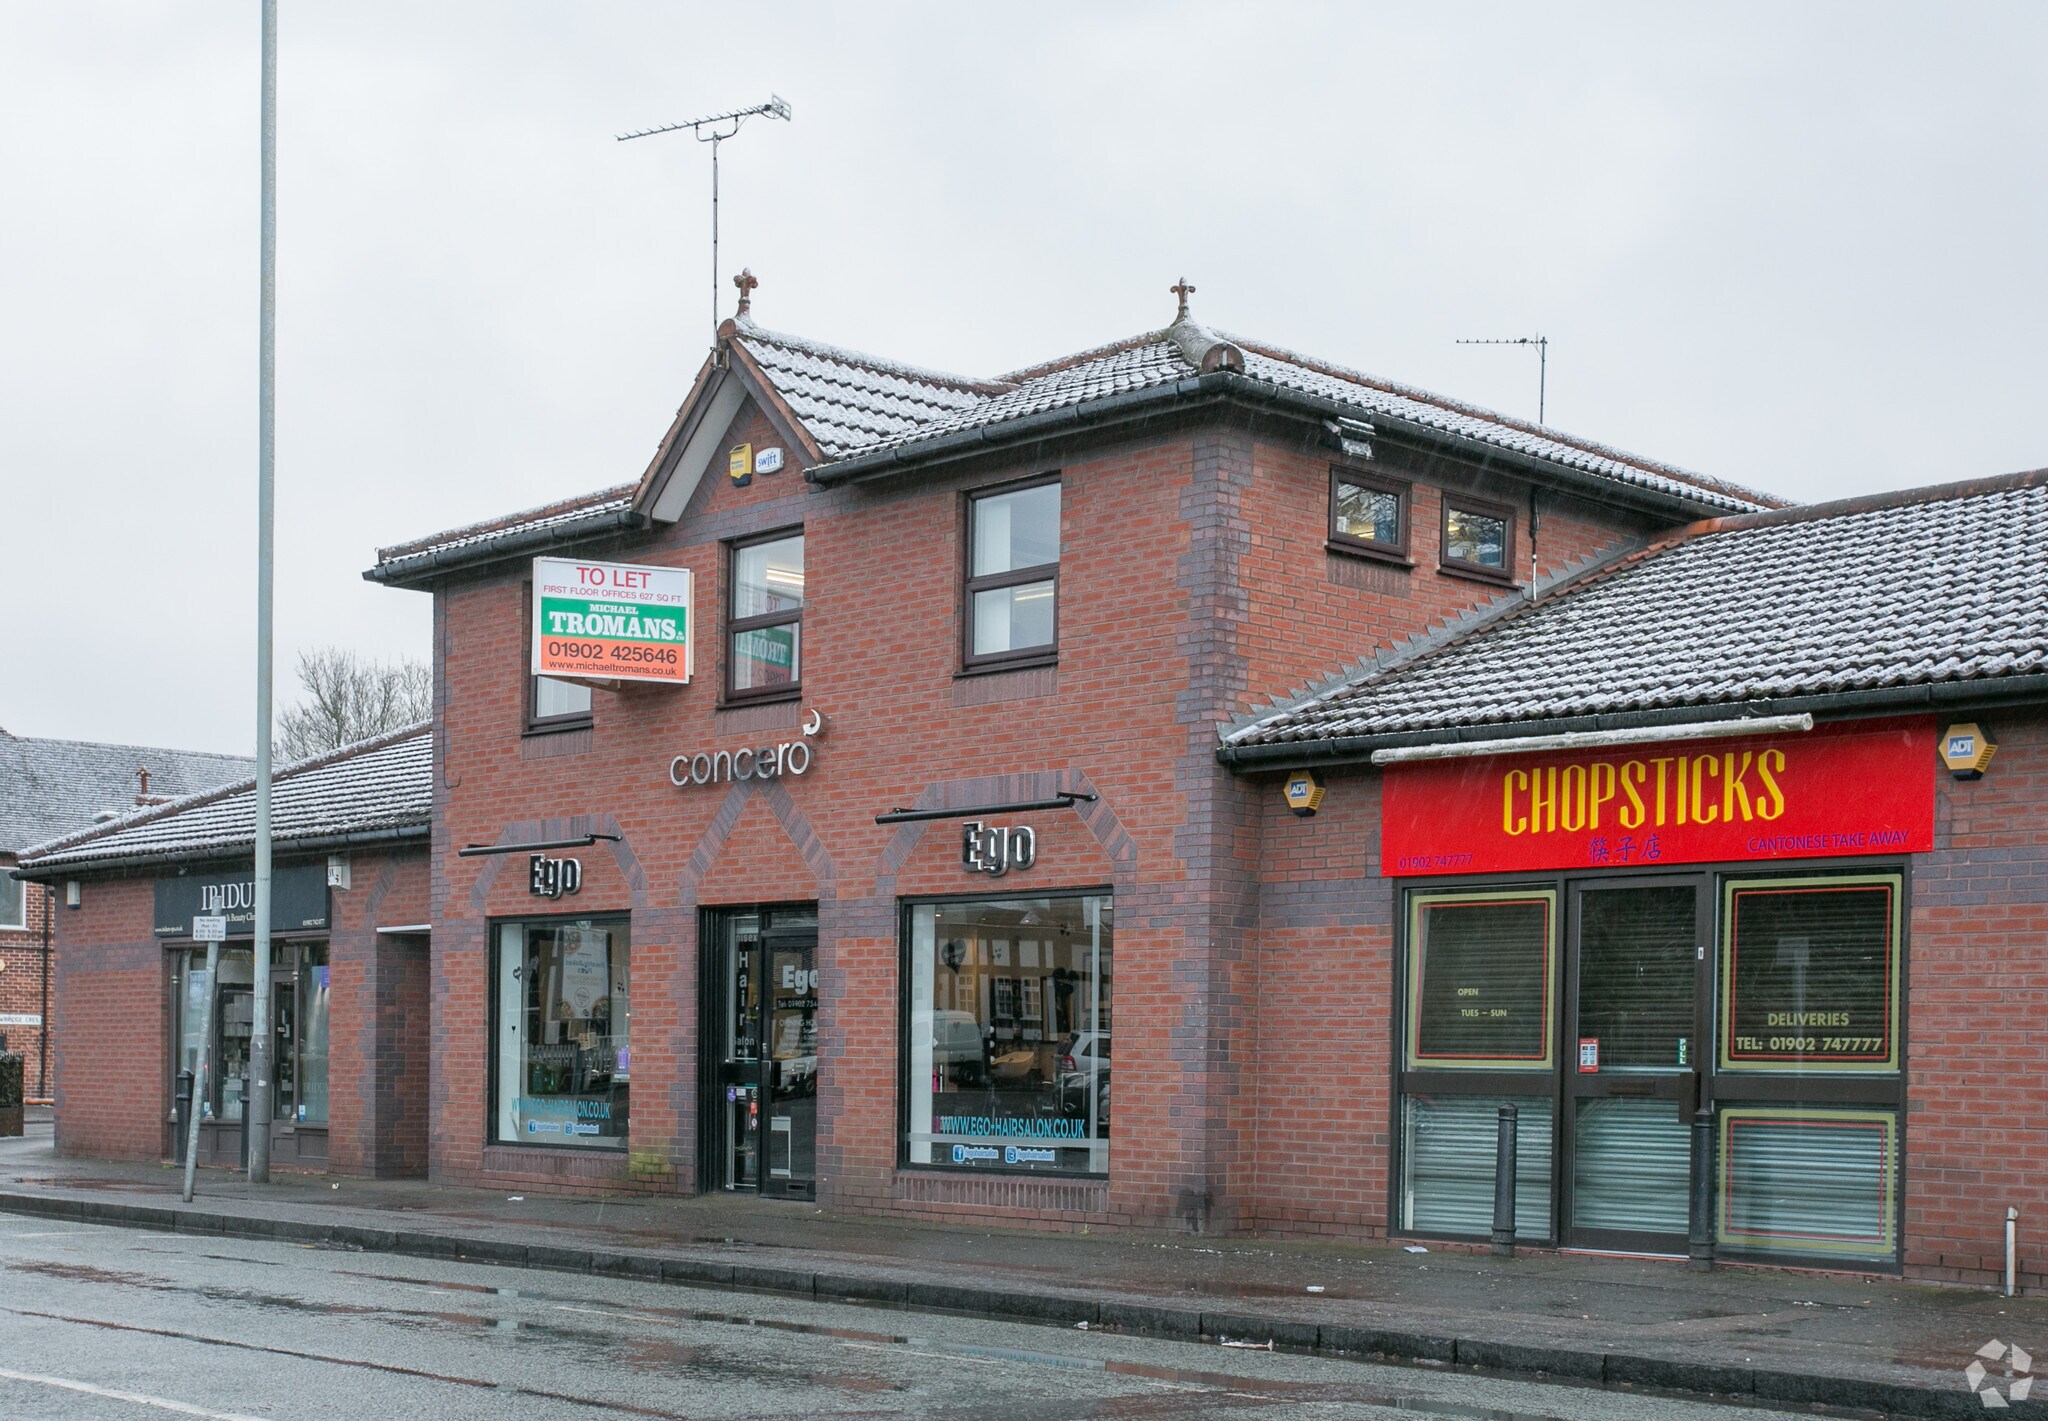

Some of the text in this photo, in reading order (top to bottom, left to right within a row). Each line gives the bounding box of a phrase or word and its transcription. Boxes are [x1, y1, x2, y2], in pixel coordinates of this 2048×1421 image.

[576, 567, 651, 588] TO LET
[544, 585, 567, 594] FIRST
[570, 587, 599, 596] FLOOR
[602, 590, 636, 600] OFFICES
[589, 604, 638, 614] MICHAEL
[550, 611, 676, 640] TROMANS
[549, 642, 677, 663] 01902 425646
[549, 661, 677, 676] www.michaeltromans.co.uk
[1950, 740, 1974, 753] ADT
[1290, 784, 1307, 794] ADT
[1503, 749, 1785, 836] CHOPSTICKS
[1590, 833, 1662, 863] 筷子店
[1748, 830, 1909, 851] CANTONESE TAKE AWAY
[963, 821, 1036, 877] Ego
[1400, 854, 1472, 868] 01902 747777
[530, 854, 581, 900] Ego
[231, 913, 245, 923] Beauty
[1768, 1013, 1849, 1026] DELIVERIES
[1736, 1037, 1882, 1051] TEL: 01902 747777
